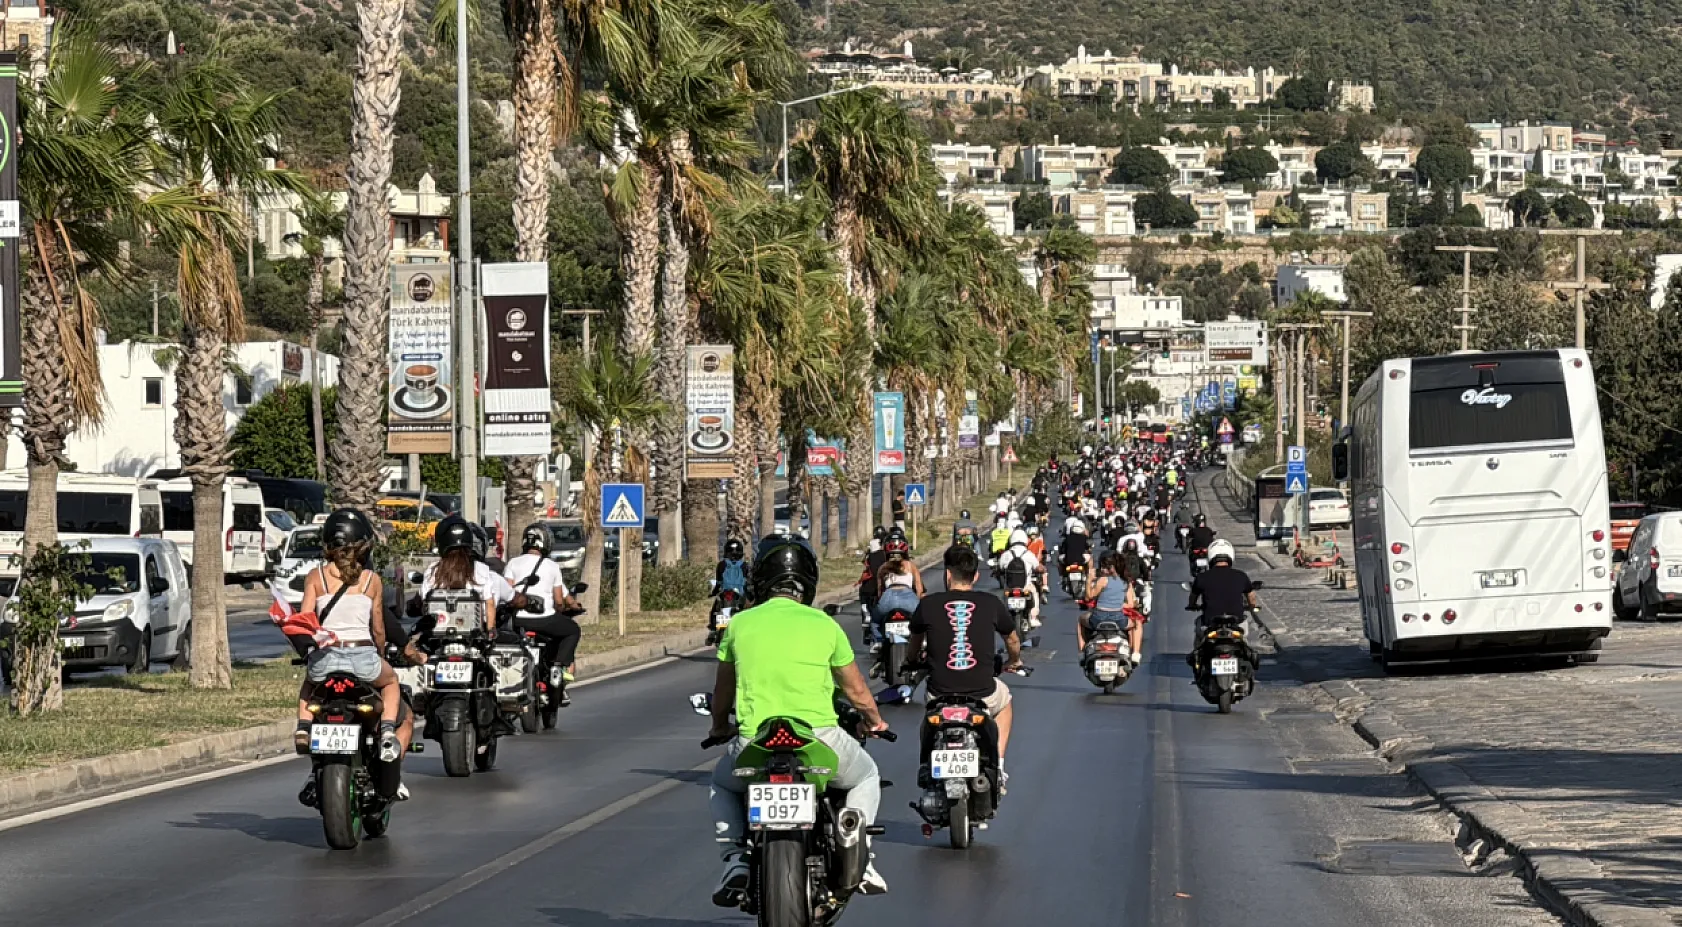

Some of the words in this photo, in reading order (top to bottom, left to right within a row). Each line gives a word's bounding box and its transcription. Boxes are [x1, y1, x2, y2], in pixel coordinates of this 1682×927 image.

[488, 412, 520, 423] online
[1292, 449, 1301, 460] D
[314, 727, 328, 736] 48
[332, 727, 355, 737] AYL
[326, 737, 348, 749] 480
[934, 753, 948, 762] 48
[951, 752, 975, 762] ASB
[947, 763, 968, 774] 406
[753, 787, 774, 801] 35
[779, 787, 810, 801] CBY
[768, 804, 799, 819] 097
